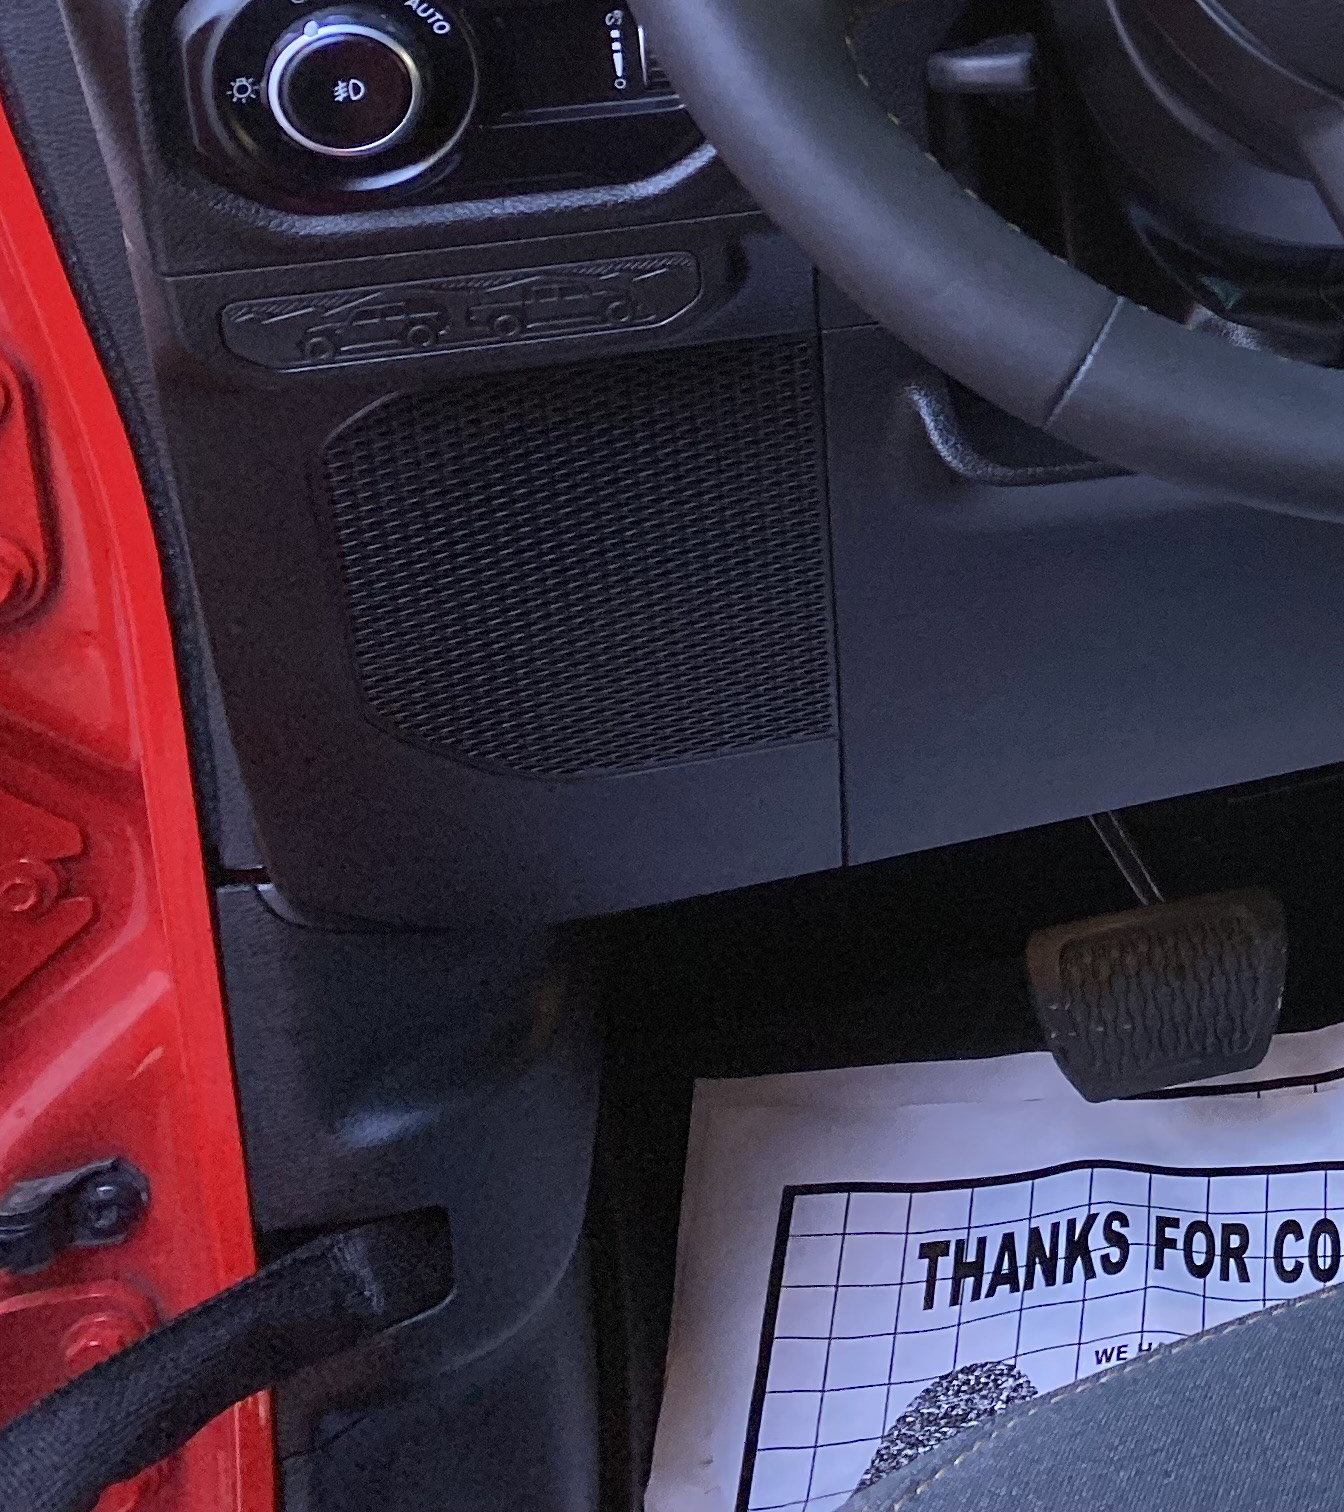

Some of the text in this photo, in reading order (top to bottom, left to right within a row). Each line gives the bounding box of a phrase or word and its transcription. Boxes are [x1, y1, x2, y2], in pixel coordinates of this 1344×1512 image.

[918, 1211, 1130, 1311] THANKS
[1154, 1215, 1250, 1284] FOR
[1094, 1344, 1129, 1366] WE
